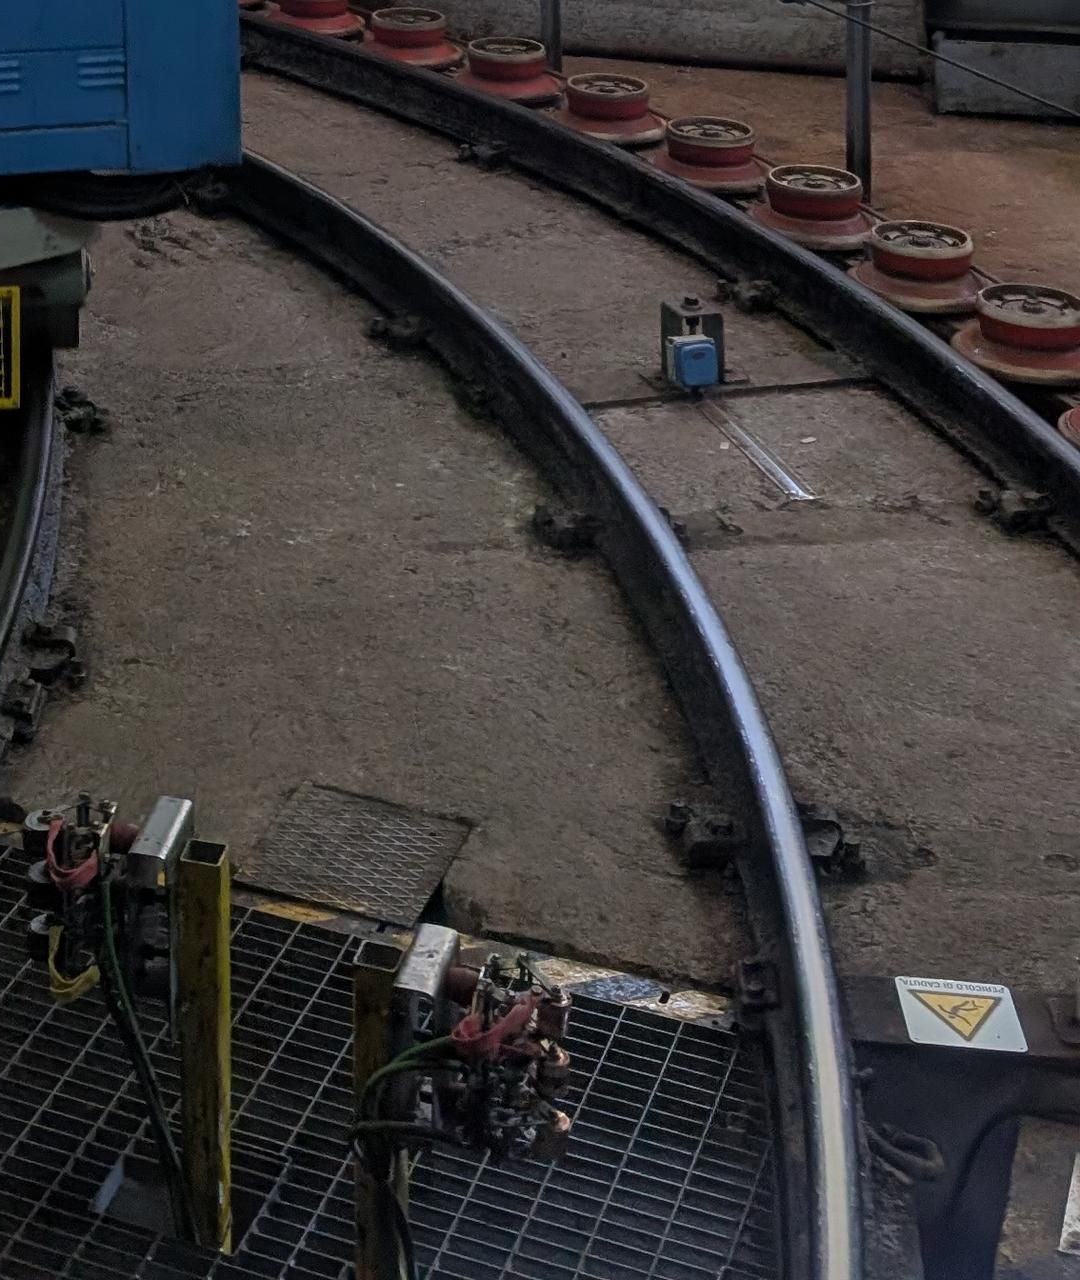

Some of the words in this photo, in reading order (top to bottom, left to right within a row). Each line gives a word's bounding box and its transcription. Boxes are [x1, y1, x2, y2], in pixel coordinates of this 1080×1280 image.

[903, 979, 940, 989] CADUTA
[942, 981, 953, 989] DI
[956, 983, 1005, 994] PERICOLO
